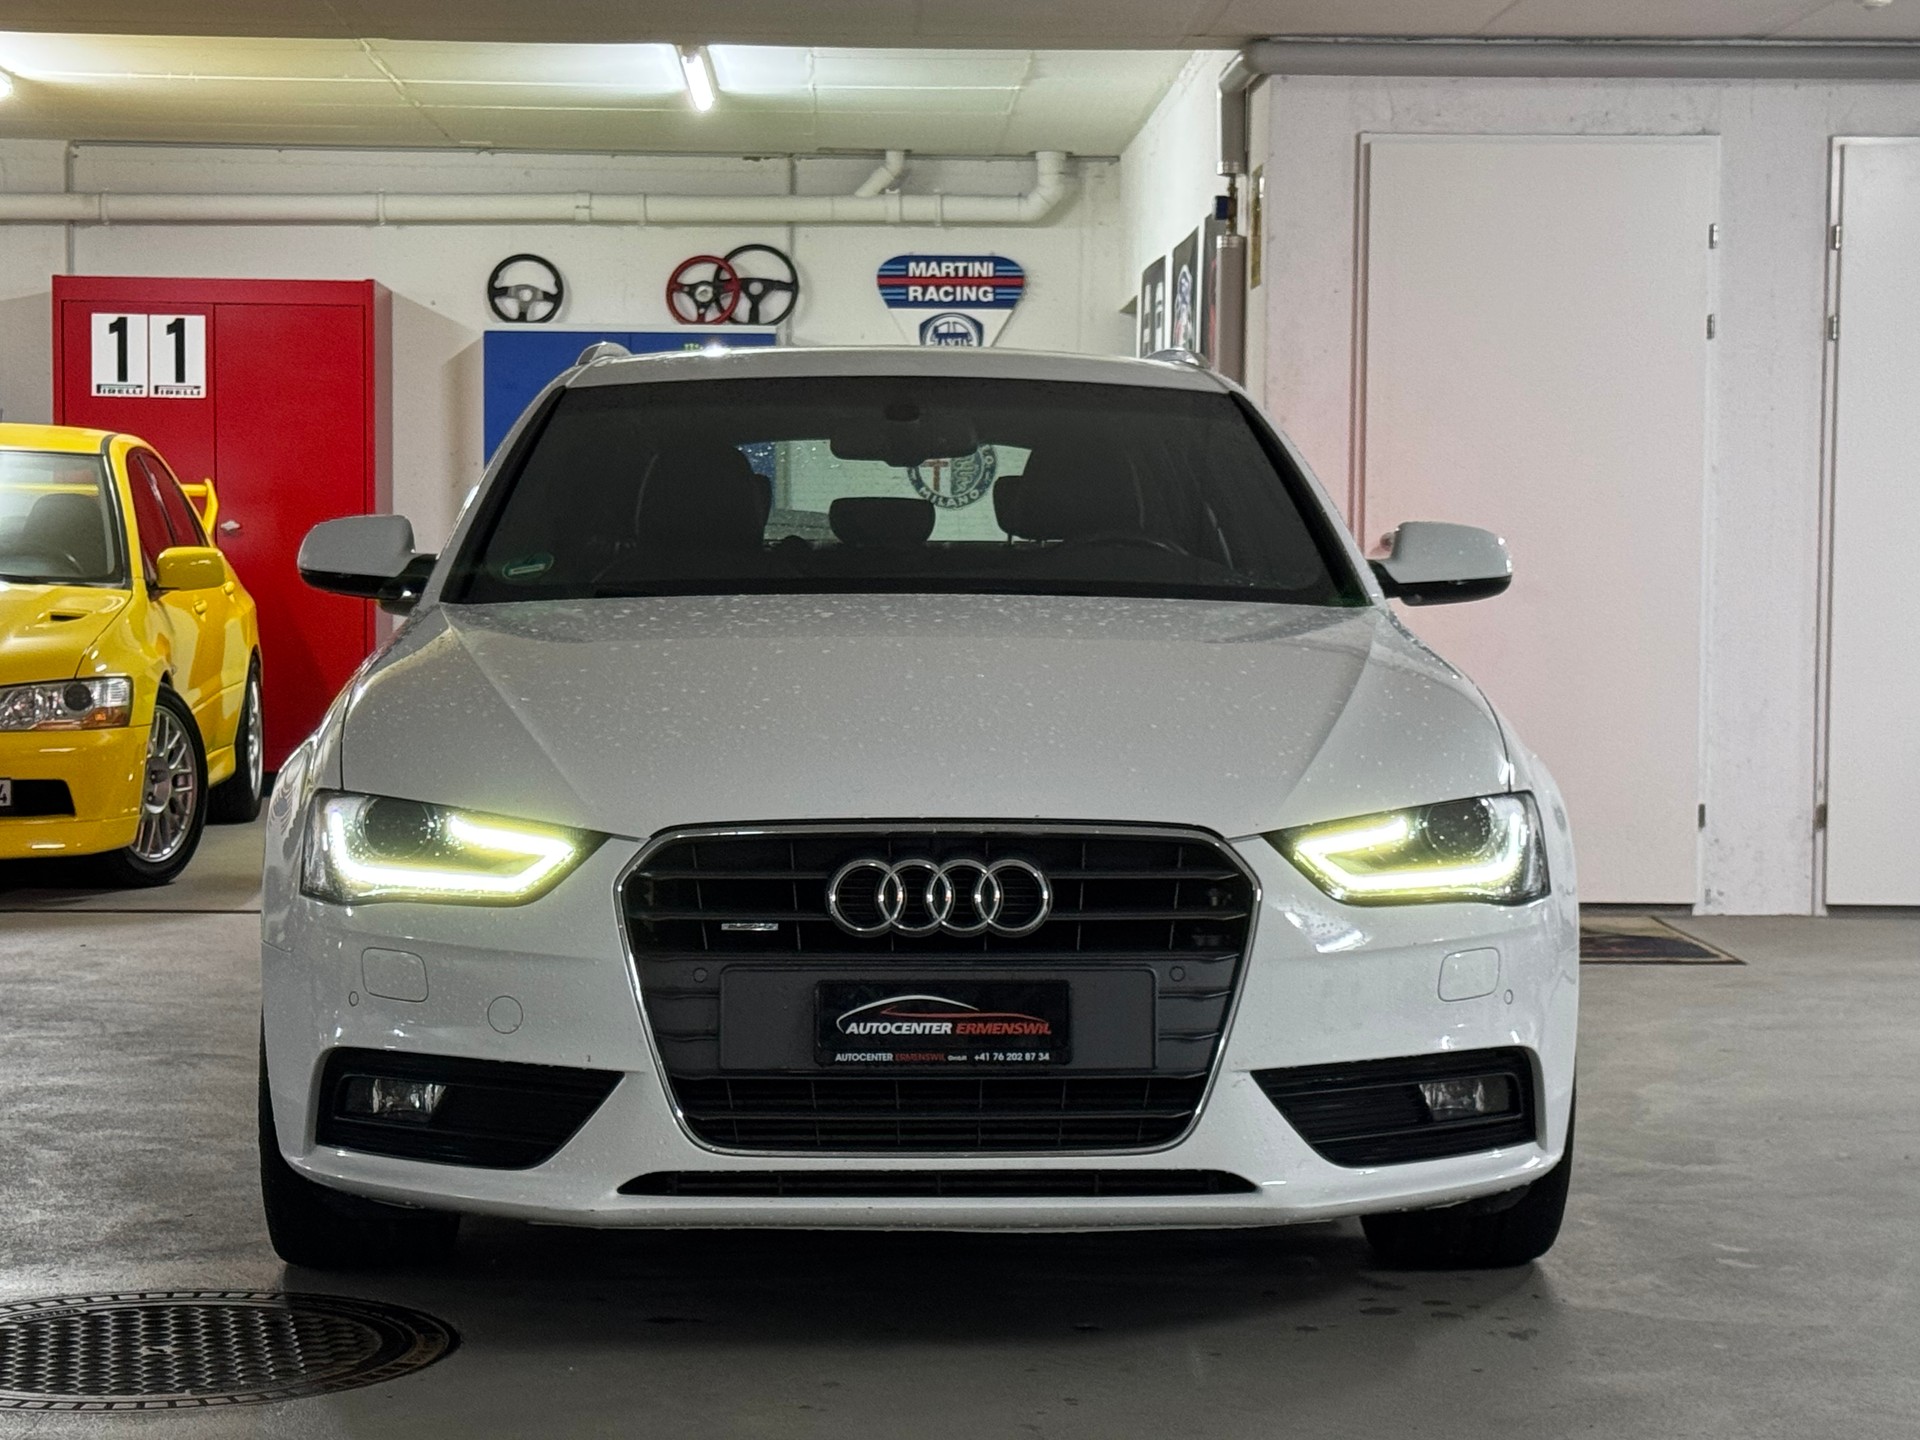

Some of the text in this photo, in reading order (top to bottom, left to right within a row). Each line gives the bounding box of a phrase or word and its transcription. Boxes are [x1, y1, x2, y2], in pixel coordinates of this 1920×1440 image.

[908, 261, 994, 277] MARTINI
[908, 286, 994, 302] RACING
[919, 487, 979, 507] MILANO
[845, 1022, 1051, 1035] AUTOCENTER ERMENSWIL
[835, 1053, 894, 1062] AUTOCENTER
[974, 1052, 990, 1061] +41
[993, 1052, 1004, 1061] 76
[1006, 1052, 1023, 1061] 202
[1038, 1052, 1050, 1061] 34
